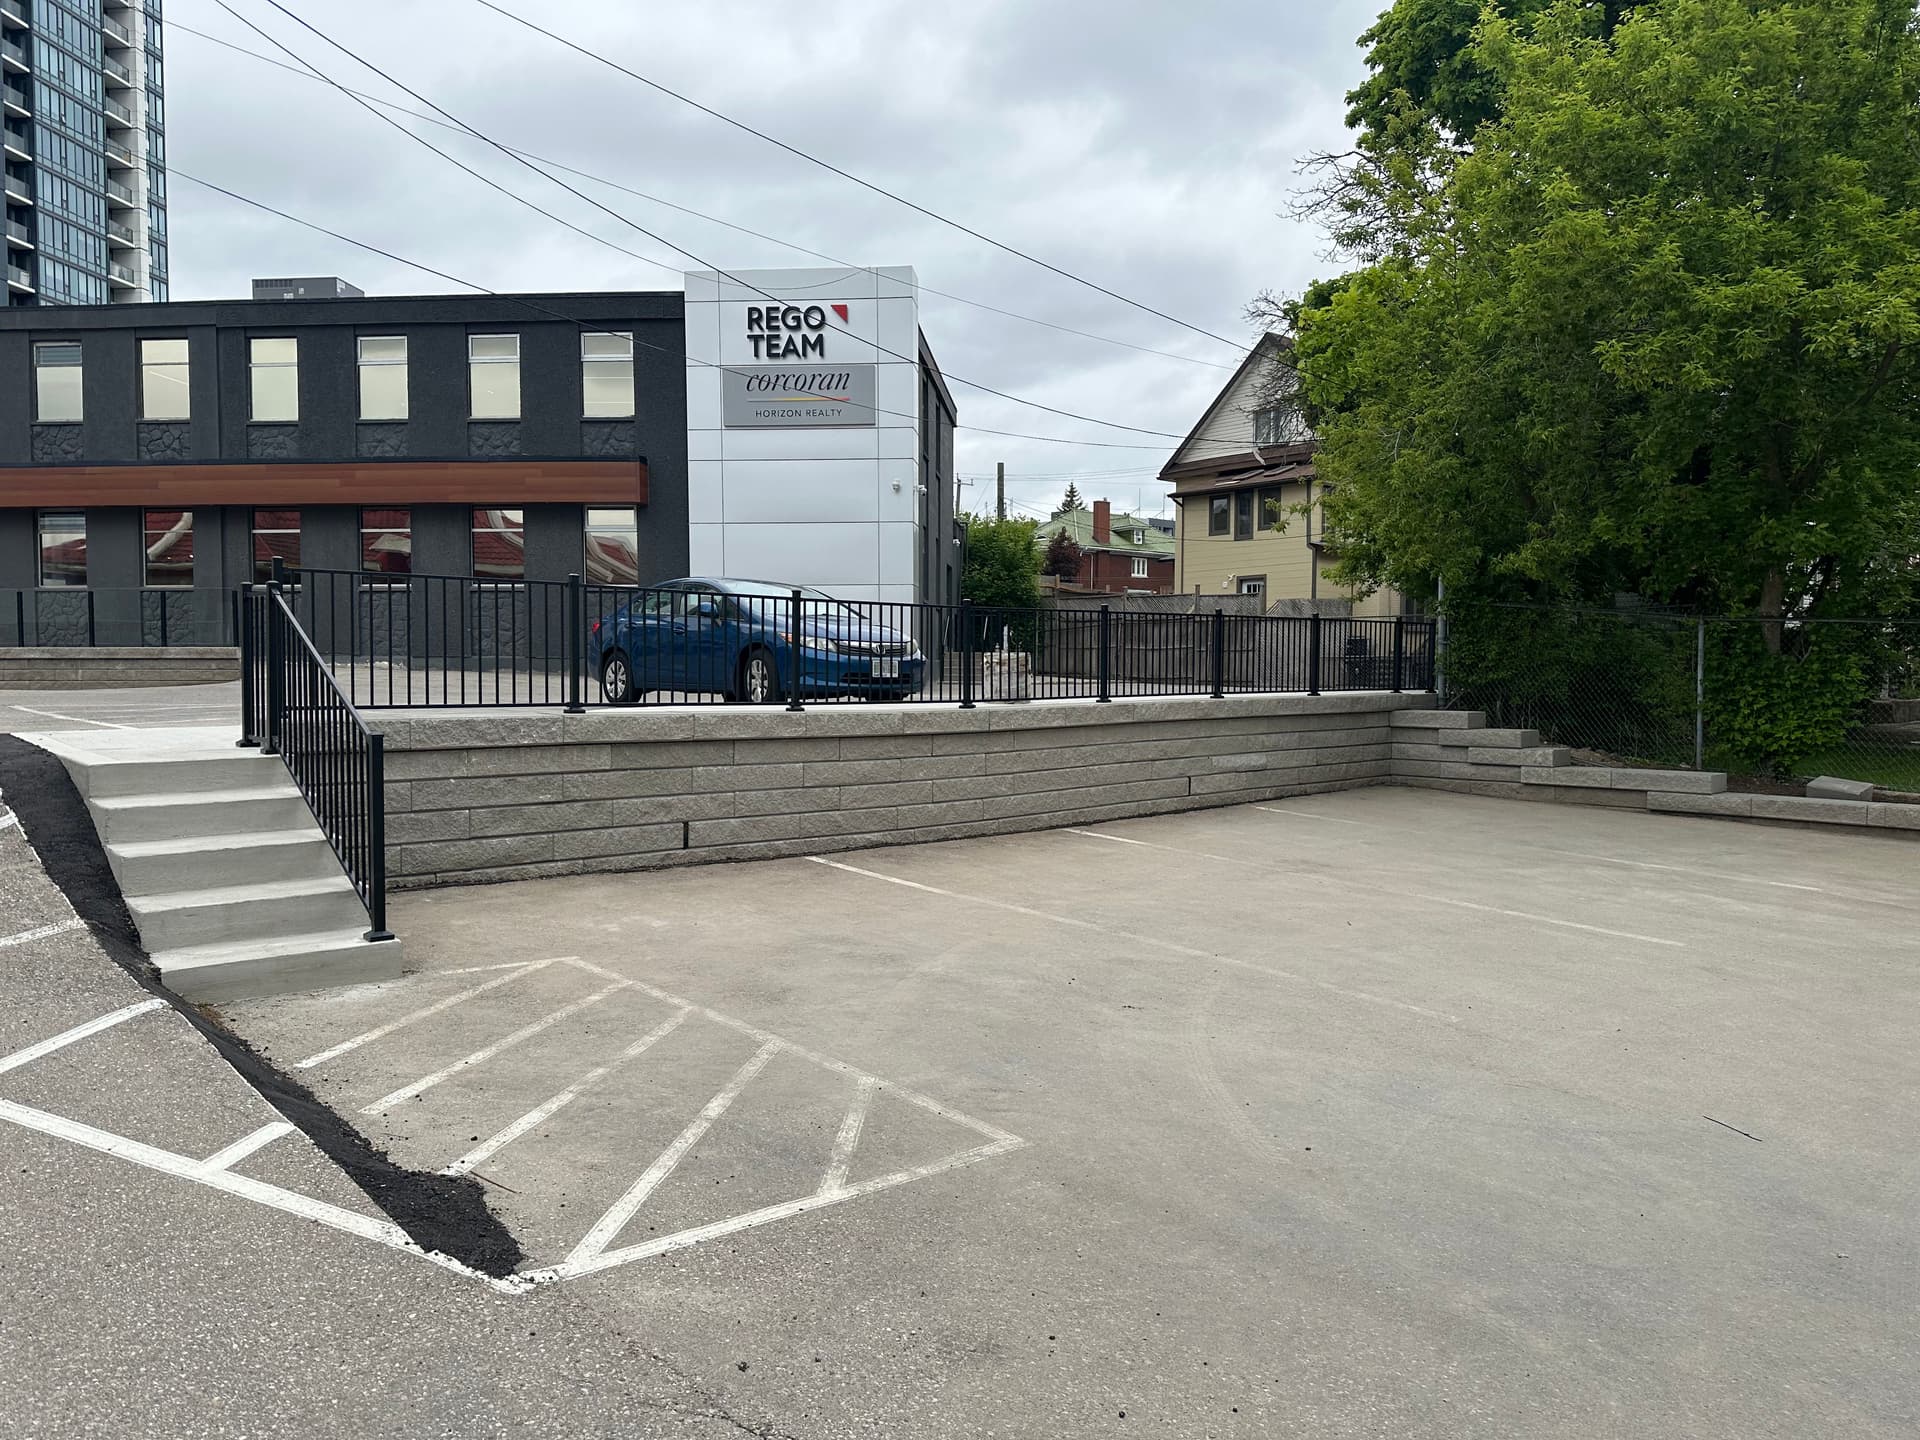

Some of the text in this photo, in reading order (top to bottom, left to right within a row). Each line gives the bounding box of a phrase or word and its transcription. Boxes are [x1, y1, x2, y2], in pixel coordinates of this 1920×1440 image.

[747, 305, 826, 331] REGO
[747, 333, 825, 358] TEAM
[746, 371, 850, 392] corcoran
[755, 408, 842, 418] HORIZON REALTY
